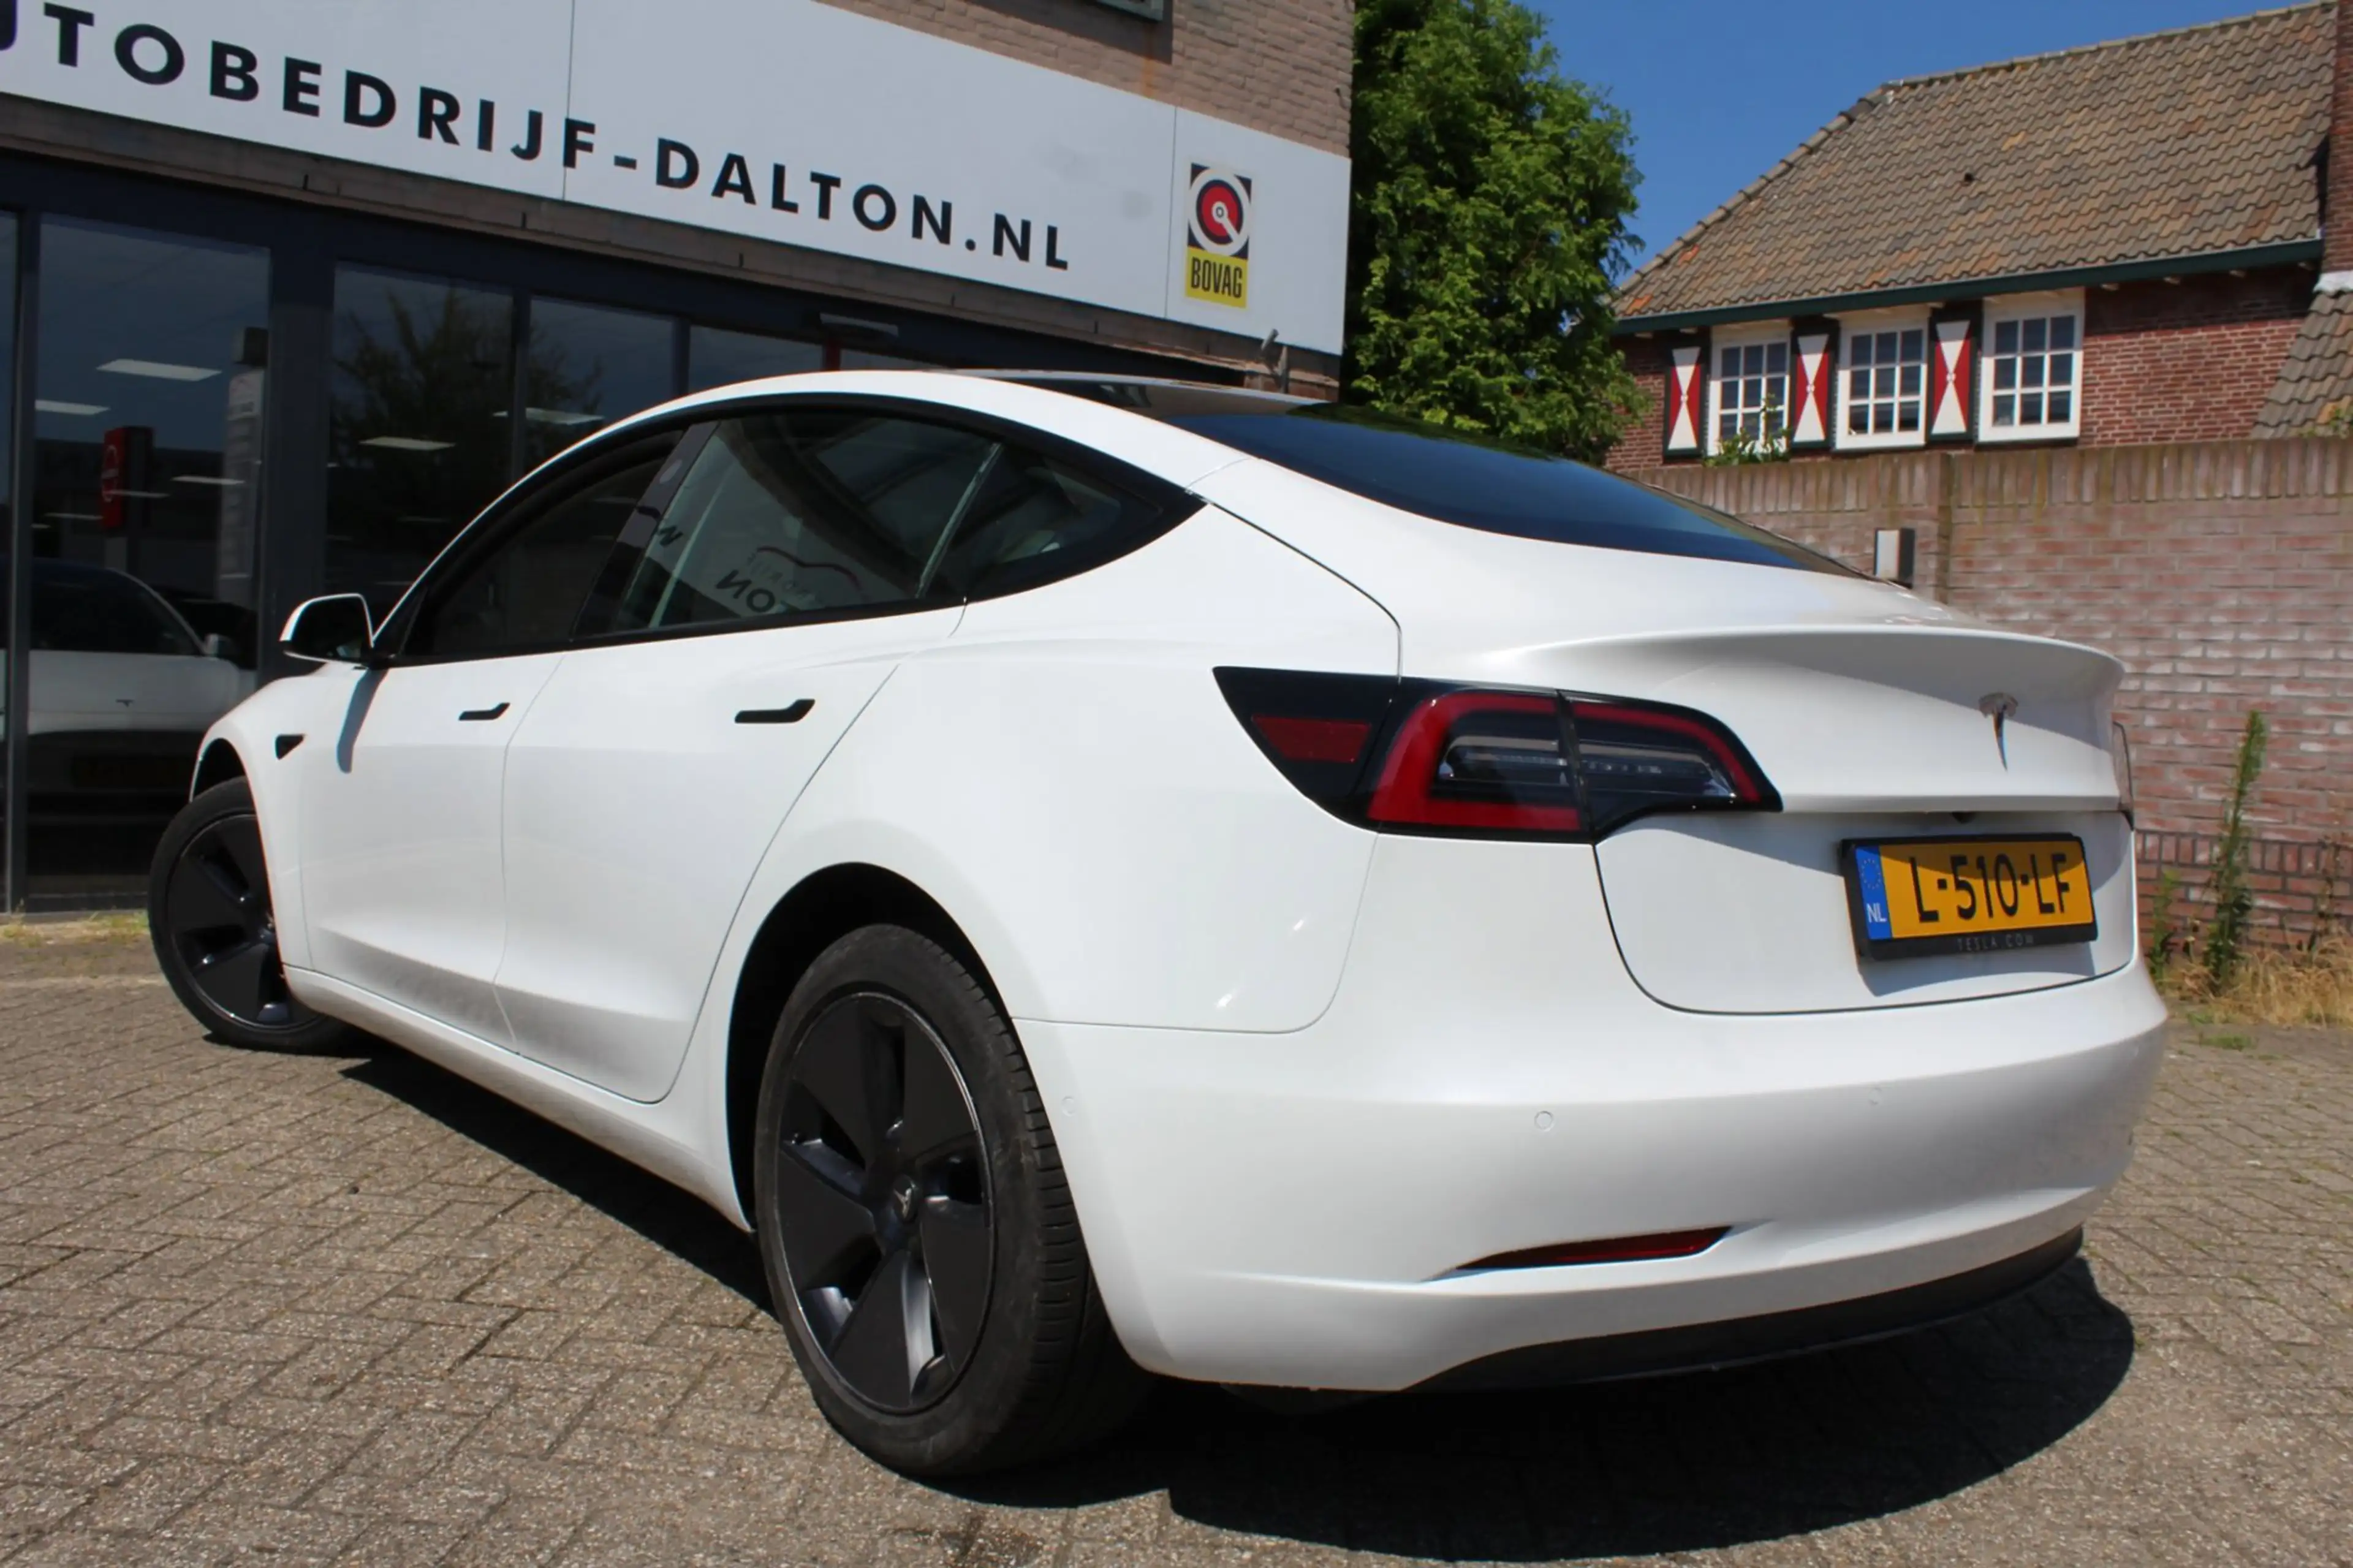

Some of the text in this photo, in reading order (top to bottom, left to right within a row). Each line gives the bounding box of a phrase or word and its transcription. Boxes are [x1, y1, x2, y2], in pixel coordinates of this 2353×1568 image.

[1191, 257, 1243, 299] BOVAG
[1909, 852, 2071, 923] L-510-LF
[1866, 903, 1887, 923] NL
